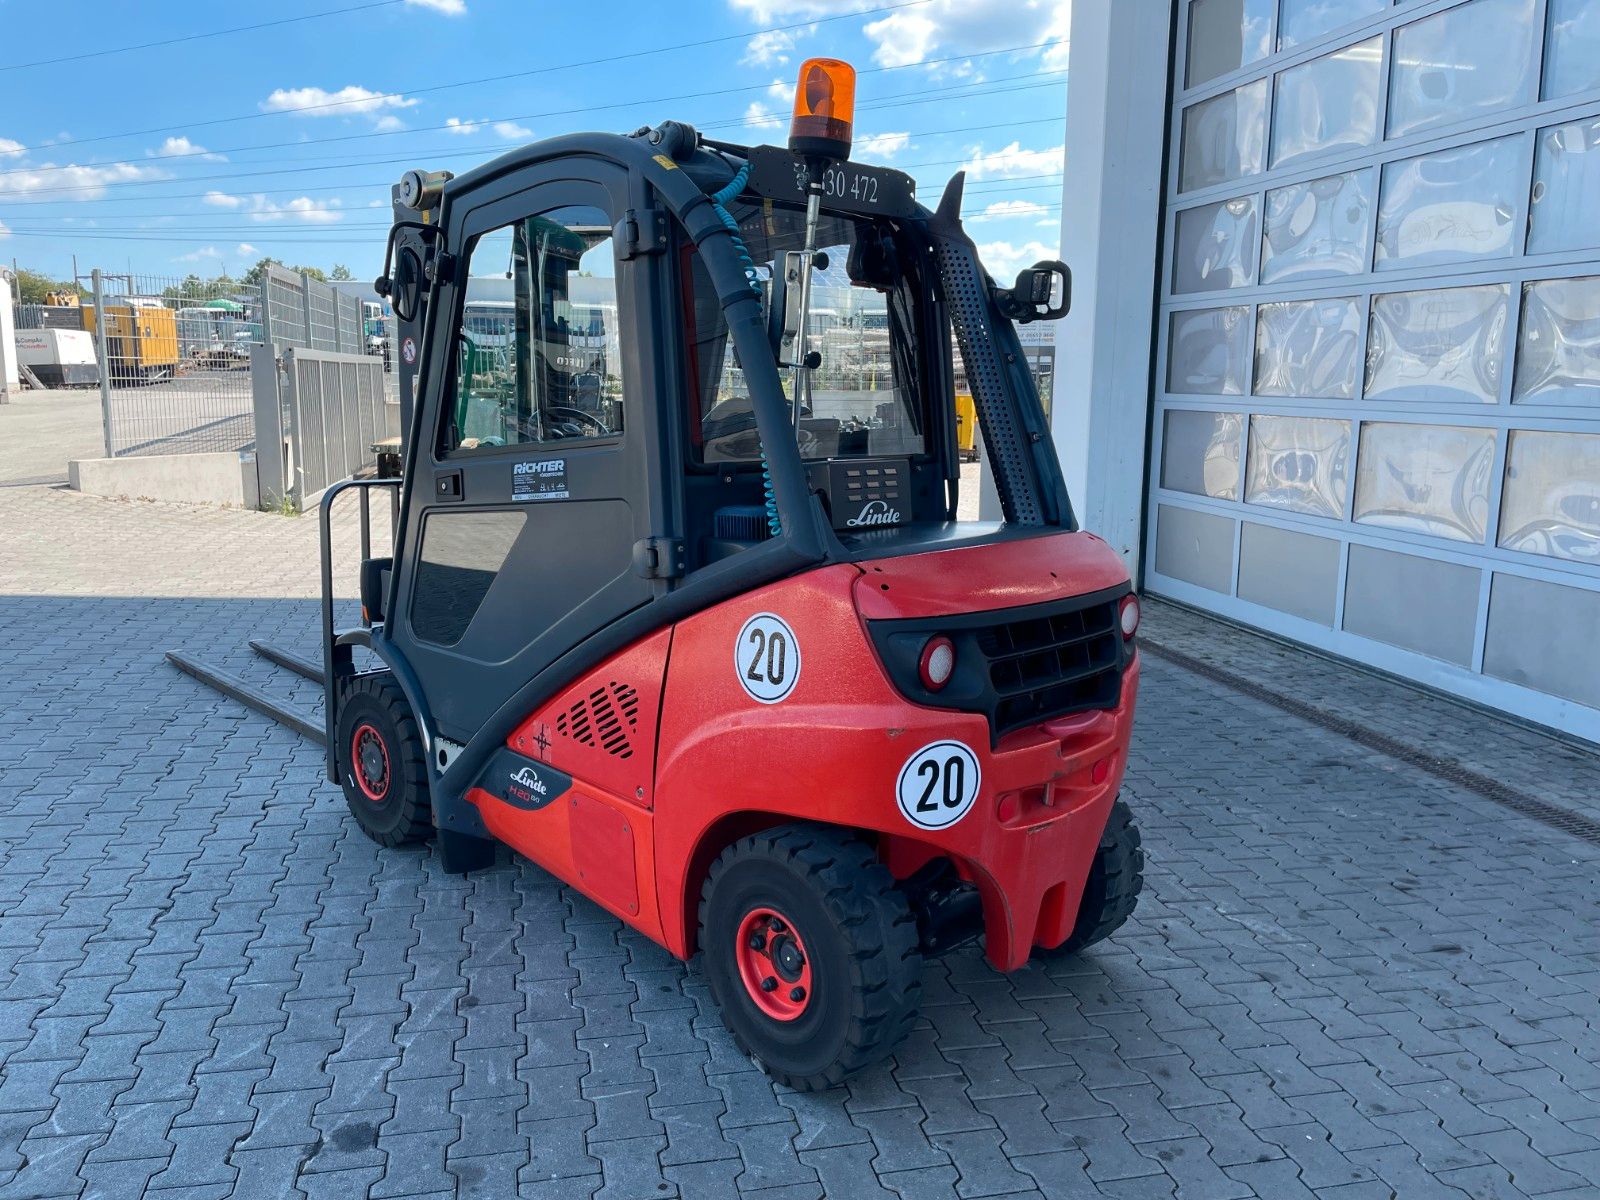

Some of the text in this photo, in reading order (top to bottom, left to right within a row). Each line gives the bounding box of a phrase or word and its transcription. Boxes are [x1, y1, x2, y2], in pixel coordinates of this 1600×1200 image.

[850, 174, 879, 204] 472
[846, 501, 900, 527] Linde
[748, 628, 786, 686] 20
[510, 766, 547, 796] Linde
[916, 755, 965, 813] 20
